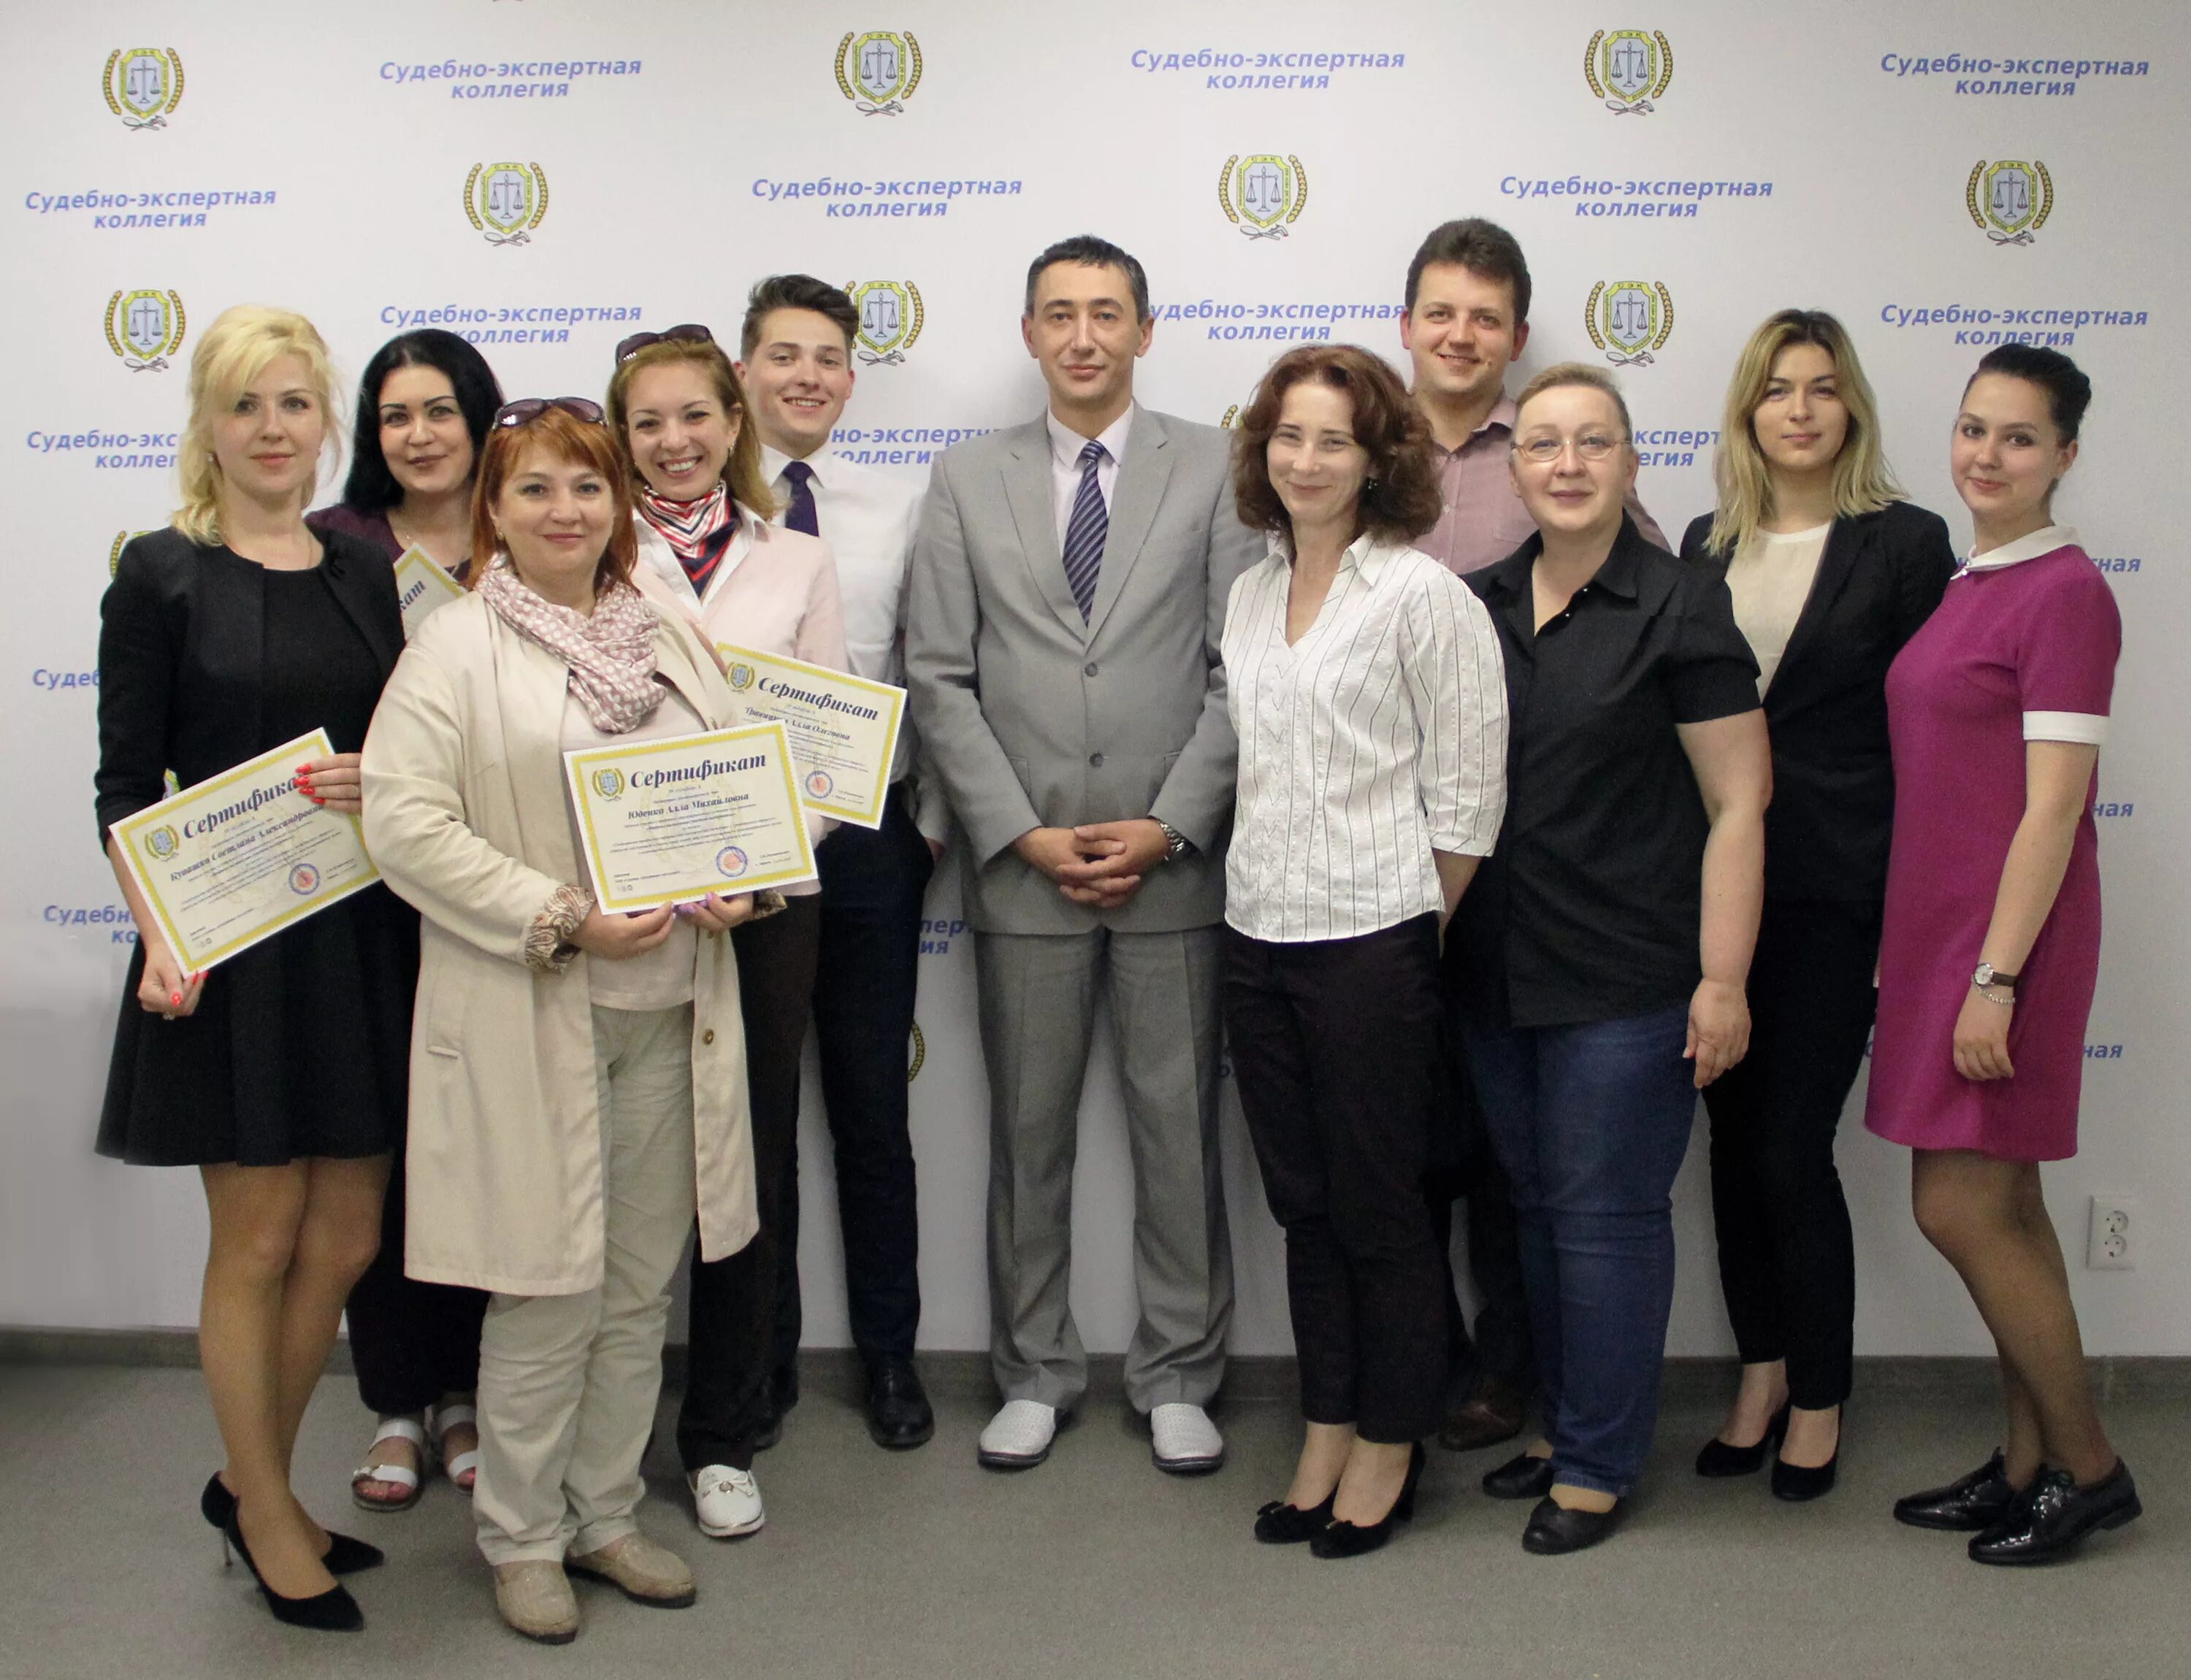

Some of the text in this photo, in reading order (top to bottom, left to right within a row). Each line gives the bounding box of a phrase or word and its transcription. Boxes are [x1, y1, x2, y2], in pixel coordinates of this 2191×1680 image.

[379, 59, 642, 82] Судебно-экспертная
[1131, 48, 1406, 72] Судебно-экспертная
[1880, 52, 2149, 77] Судебно-экспертная
[451, 81, 569, 99] коллегия
[1207, 72, 1330, 90] коллегия
[1955, 79, 2076, 96] коллегия
[752, 177, 1022, 200] Судебно-экспертная
[1499, 175, 1773, 200] Судебно-экспертная
[25, 188, 277, 213] Судебно-экспертная
[826, 200, 947, 218] коллегия
[1575, 200, 1698, 218] коллегия
[93, 211, 207, 229] коллегия
[380, 304, 642, 328] Судебно-экспертная
[1150, 299, 1407, 322] удебно-экспертная
[1880, 304, 2149, 328] Судебно-экспертная
[1207, 323, 1331, 340] коллегия
[1954, 329, 2075, 346] коллегия
[26, 429, 177, 453] Судебно-экс
[95, 454, 177, 469] коллег
[833, 450, 930, 464] оллеги
[758, 677, 879, 721] Сертификат
[630, 753, 767, 789] Сертификат
[183, 775, 302, 840] Сертифика
